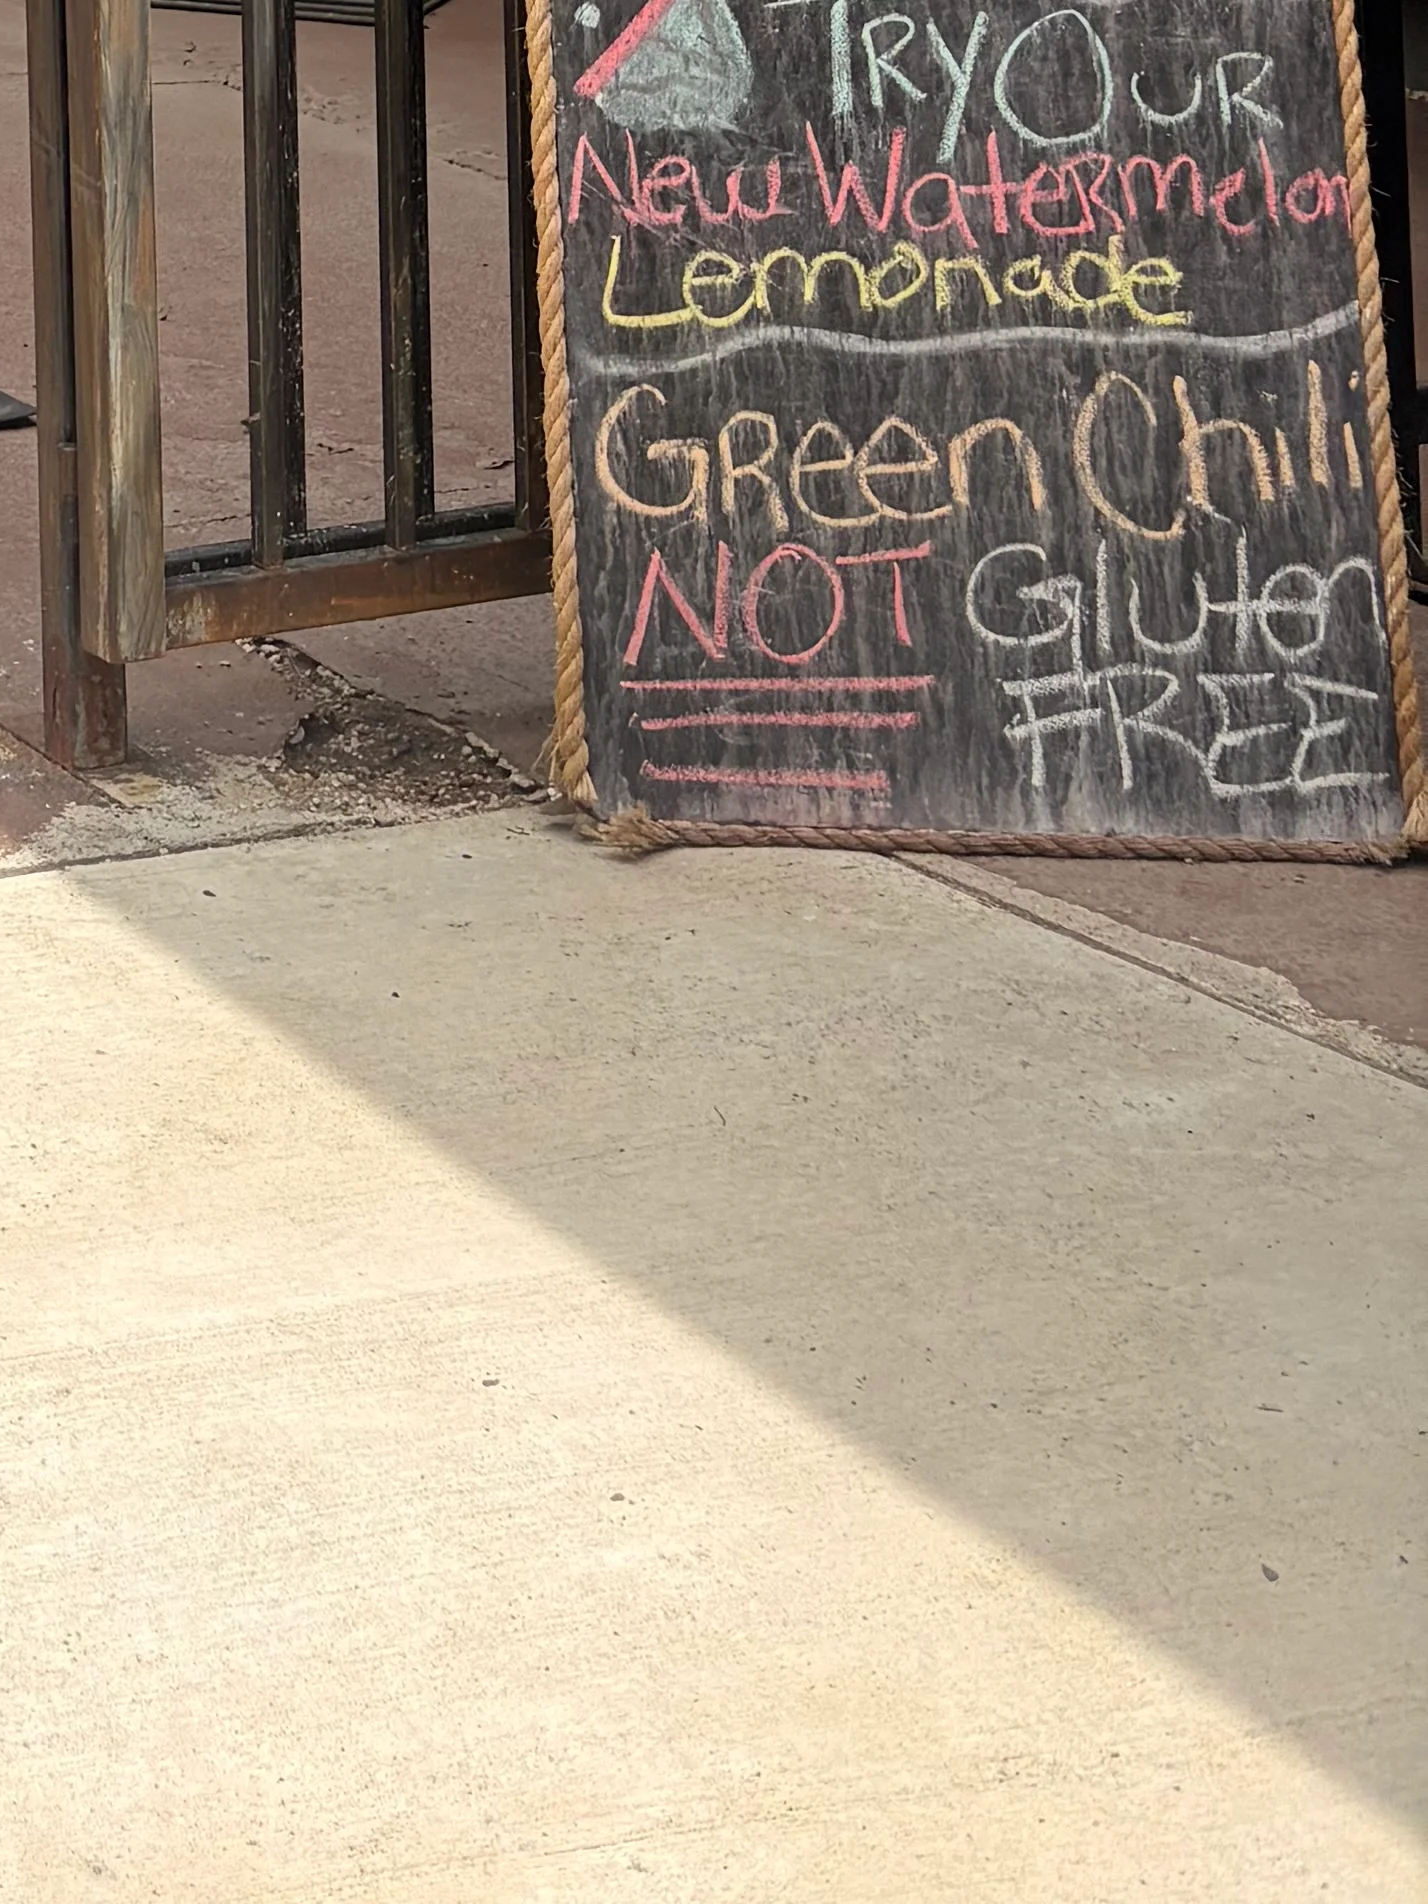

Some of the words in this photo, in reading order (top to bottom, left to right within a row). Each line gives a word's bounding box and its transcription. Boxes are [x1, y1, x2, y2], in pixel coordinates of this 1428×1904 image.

[569, 130, 792, 233] New
[601, 232, 1193, 330] Lemonade
[1072, 358, 1364, 541] Chili
[622, 538, 934, 668] NOT
[965, 524, 1389, 684] Gluten
[996, 663, 1391, 800] FREE
